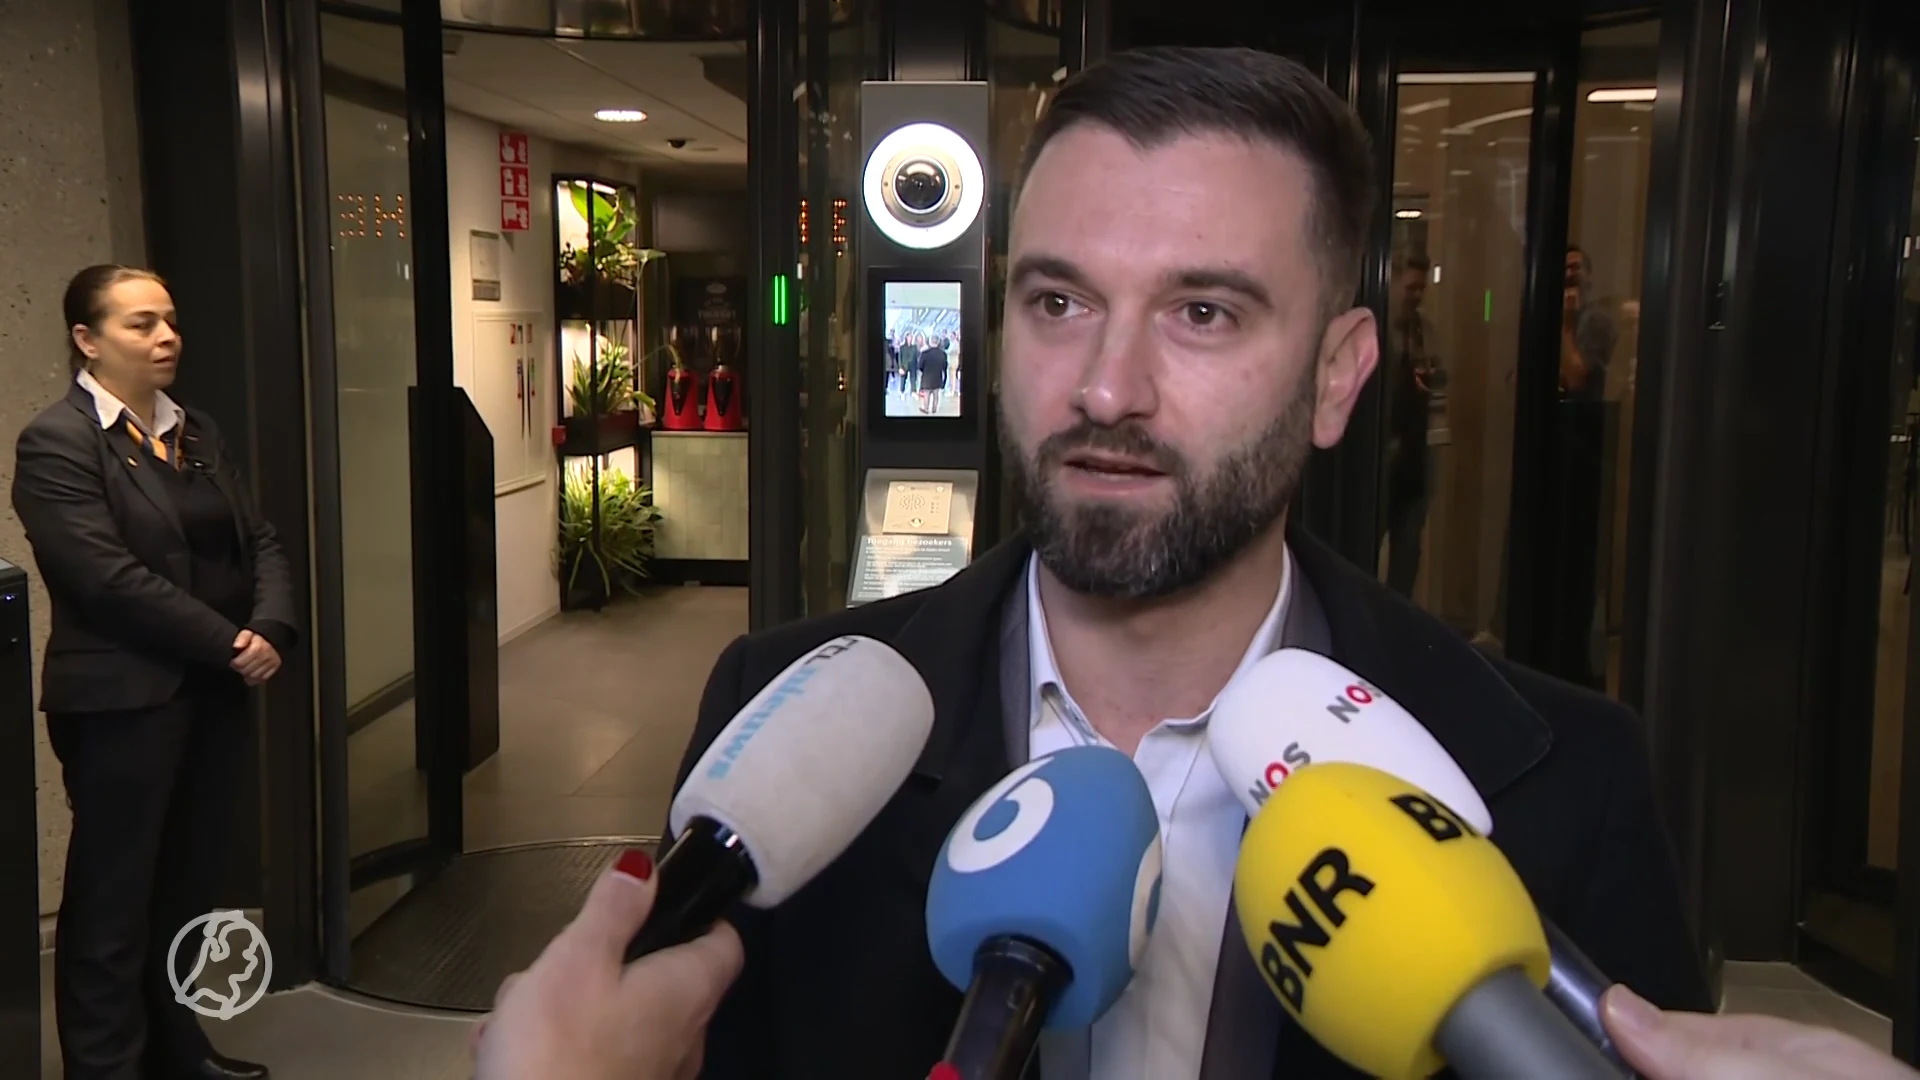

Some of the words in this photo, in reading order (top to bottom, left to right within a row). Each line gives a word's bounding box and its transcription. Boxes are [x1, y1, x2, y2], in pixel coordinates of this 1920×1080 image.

[947, 755, 1054, 874] 6
[1249, 742, 1311, 806] NOS
[1261, 846, 1376, 1015] BNR
